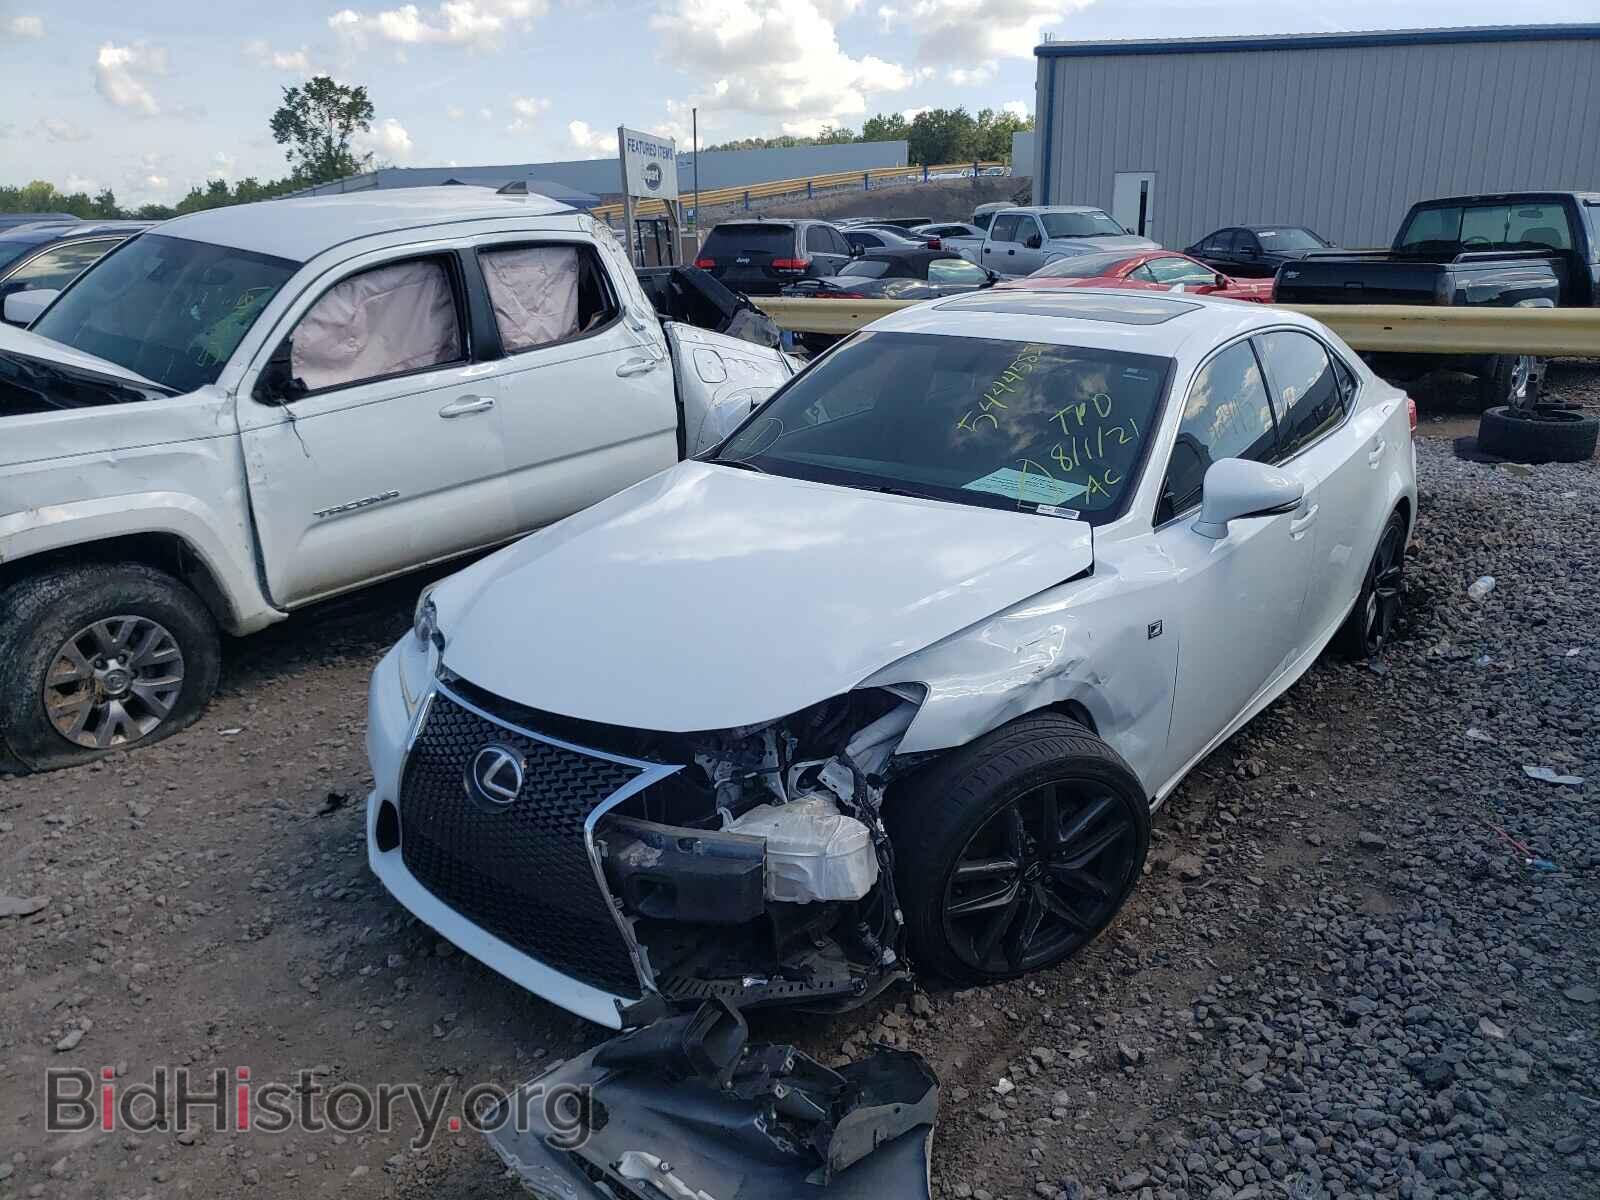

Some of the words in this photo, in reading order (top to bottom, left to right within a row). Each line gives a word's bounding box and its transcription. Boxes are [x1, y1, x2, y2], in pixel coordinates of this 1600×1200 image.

[627, 138, 656, 157] FEATURED
[657, 146, 673, 161] ITEMS
[735, 257, 751, 265] Jeep
[1050, 418, 1140, 472] 8/1/21
[1086, 468, 1122, 504] AC
